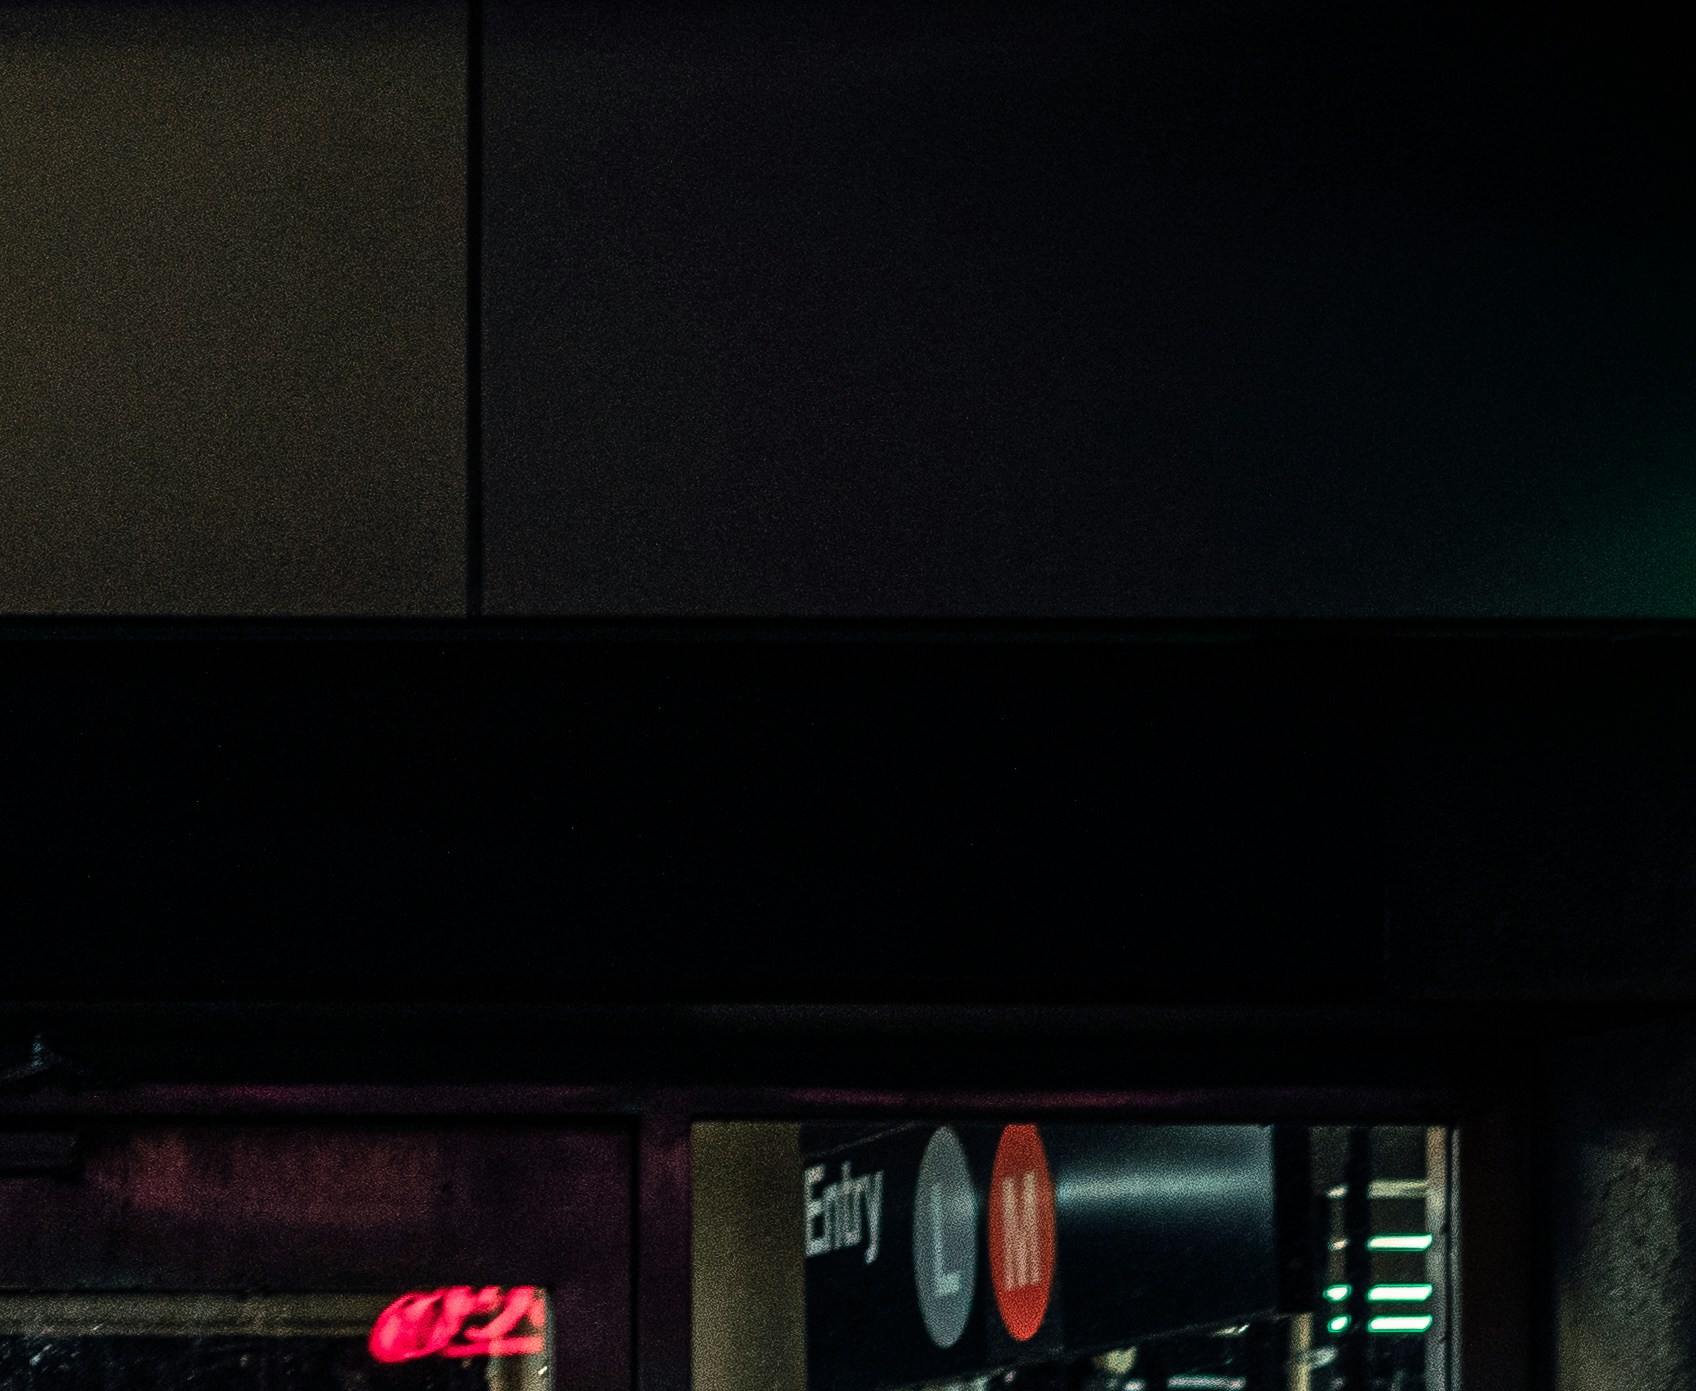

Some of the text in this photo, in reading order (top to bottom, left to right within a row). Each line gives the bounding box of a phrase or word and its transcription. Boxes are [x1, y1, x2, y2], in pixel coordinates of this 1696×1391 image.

[803, 1158, 1042, 1298] Entry L M
